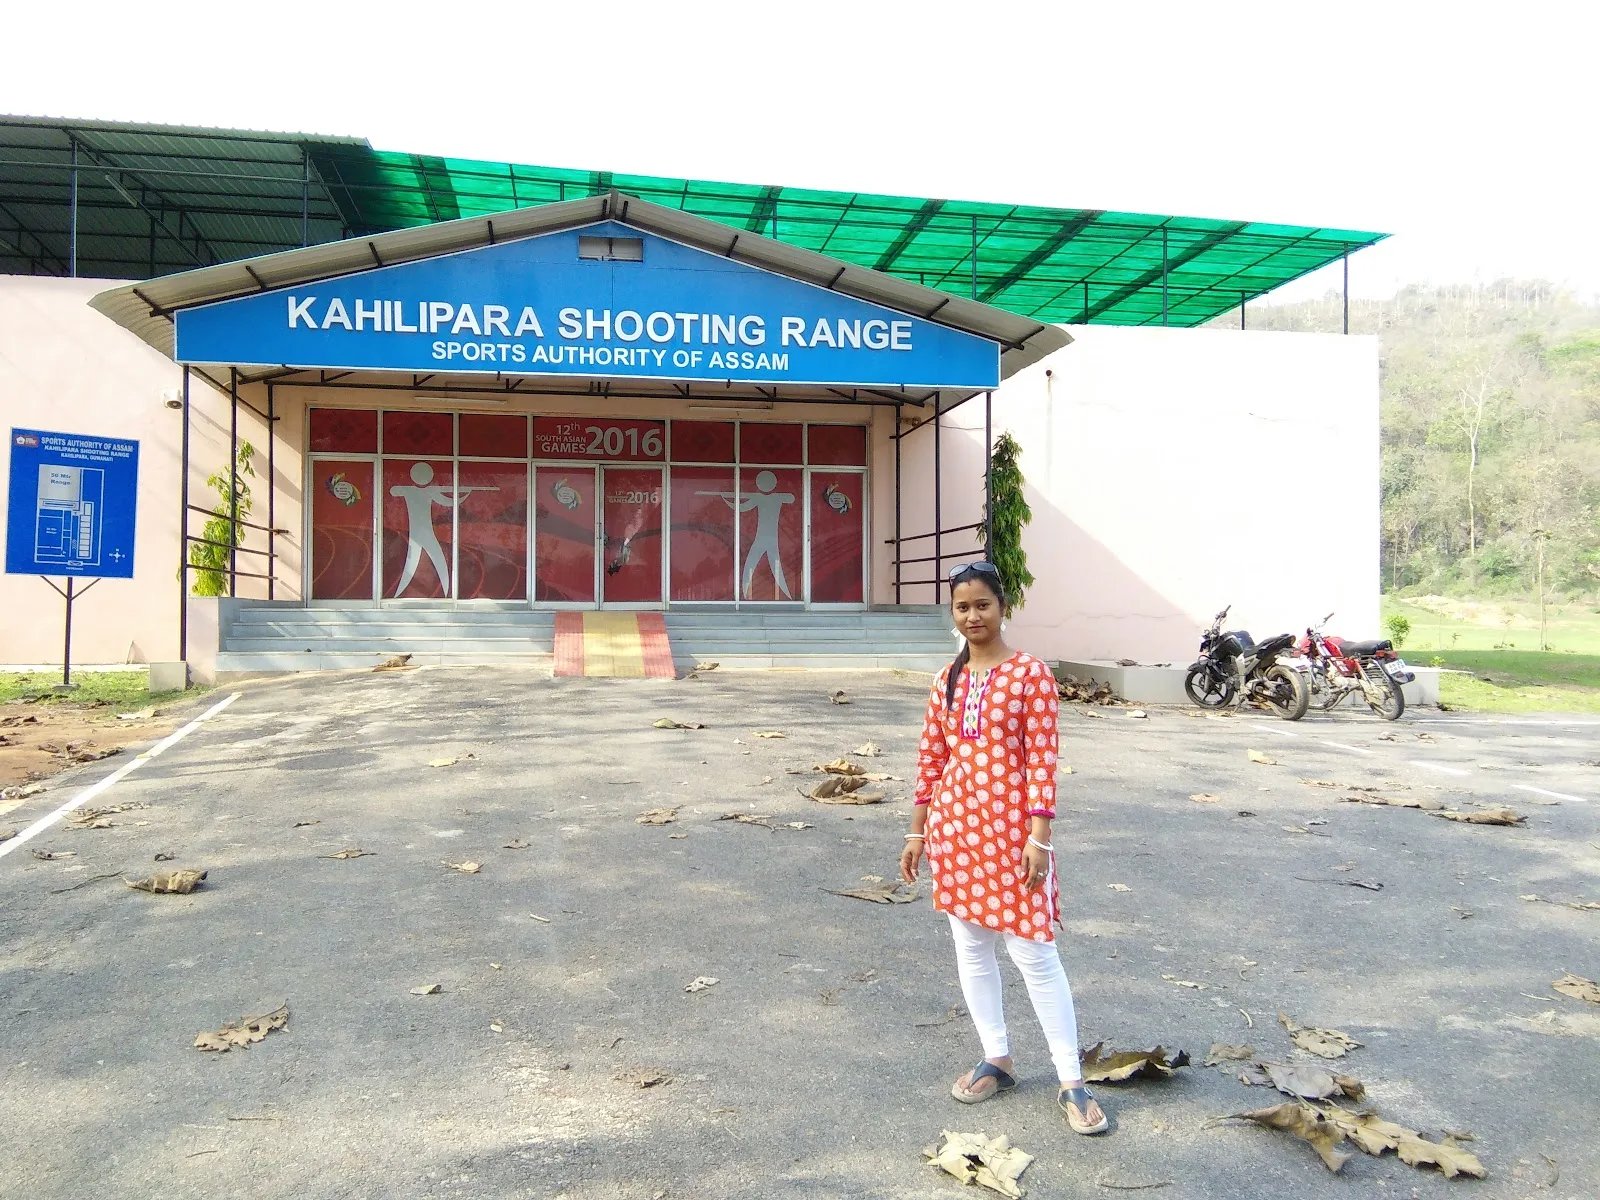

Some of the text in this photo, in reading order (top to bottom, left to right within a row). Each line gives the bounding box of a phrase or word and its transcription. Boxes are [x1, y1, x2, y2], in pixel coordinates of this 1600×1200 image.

[287, 296, 913, 351] KAHILIPARA SHOOTING RANGE
[431, 341, 789, 371] SPORTS AUTHORITY OF ASSAM
[556, 422, 581, 436] 12th
[41, 436, 66, 446] SPORTS
[67, 439, 103, 450] AUTHORITY
[103, 442, 112, 451] OF
[112, 444, 134, 453] ASSAM
[535, 434, 587, 444] SOUTH ASIAN
[585, 426, 663, 457] 2016
[541, 441, 586, 454] GAMES
[627, 491, 659, 504] 2016
